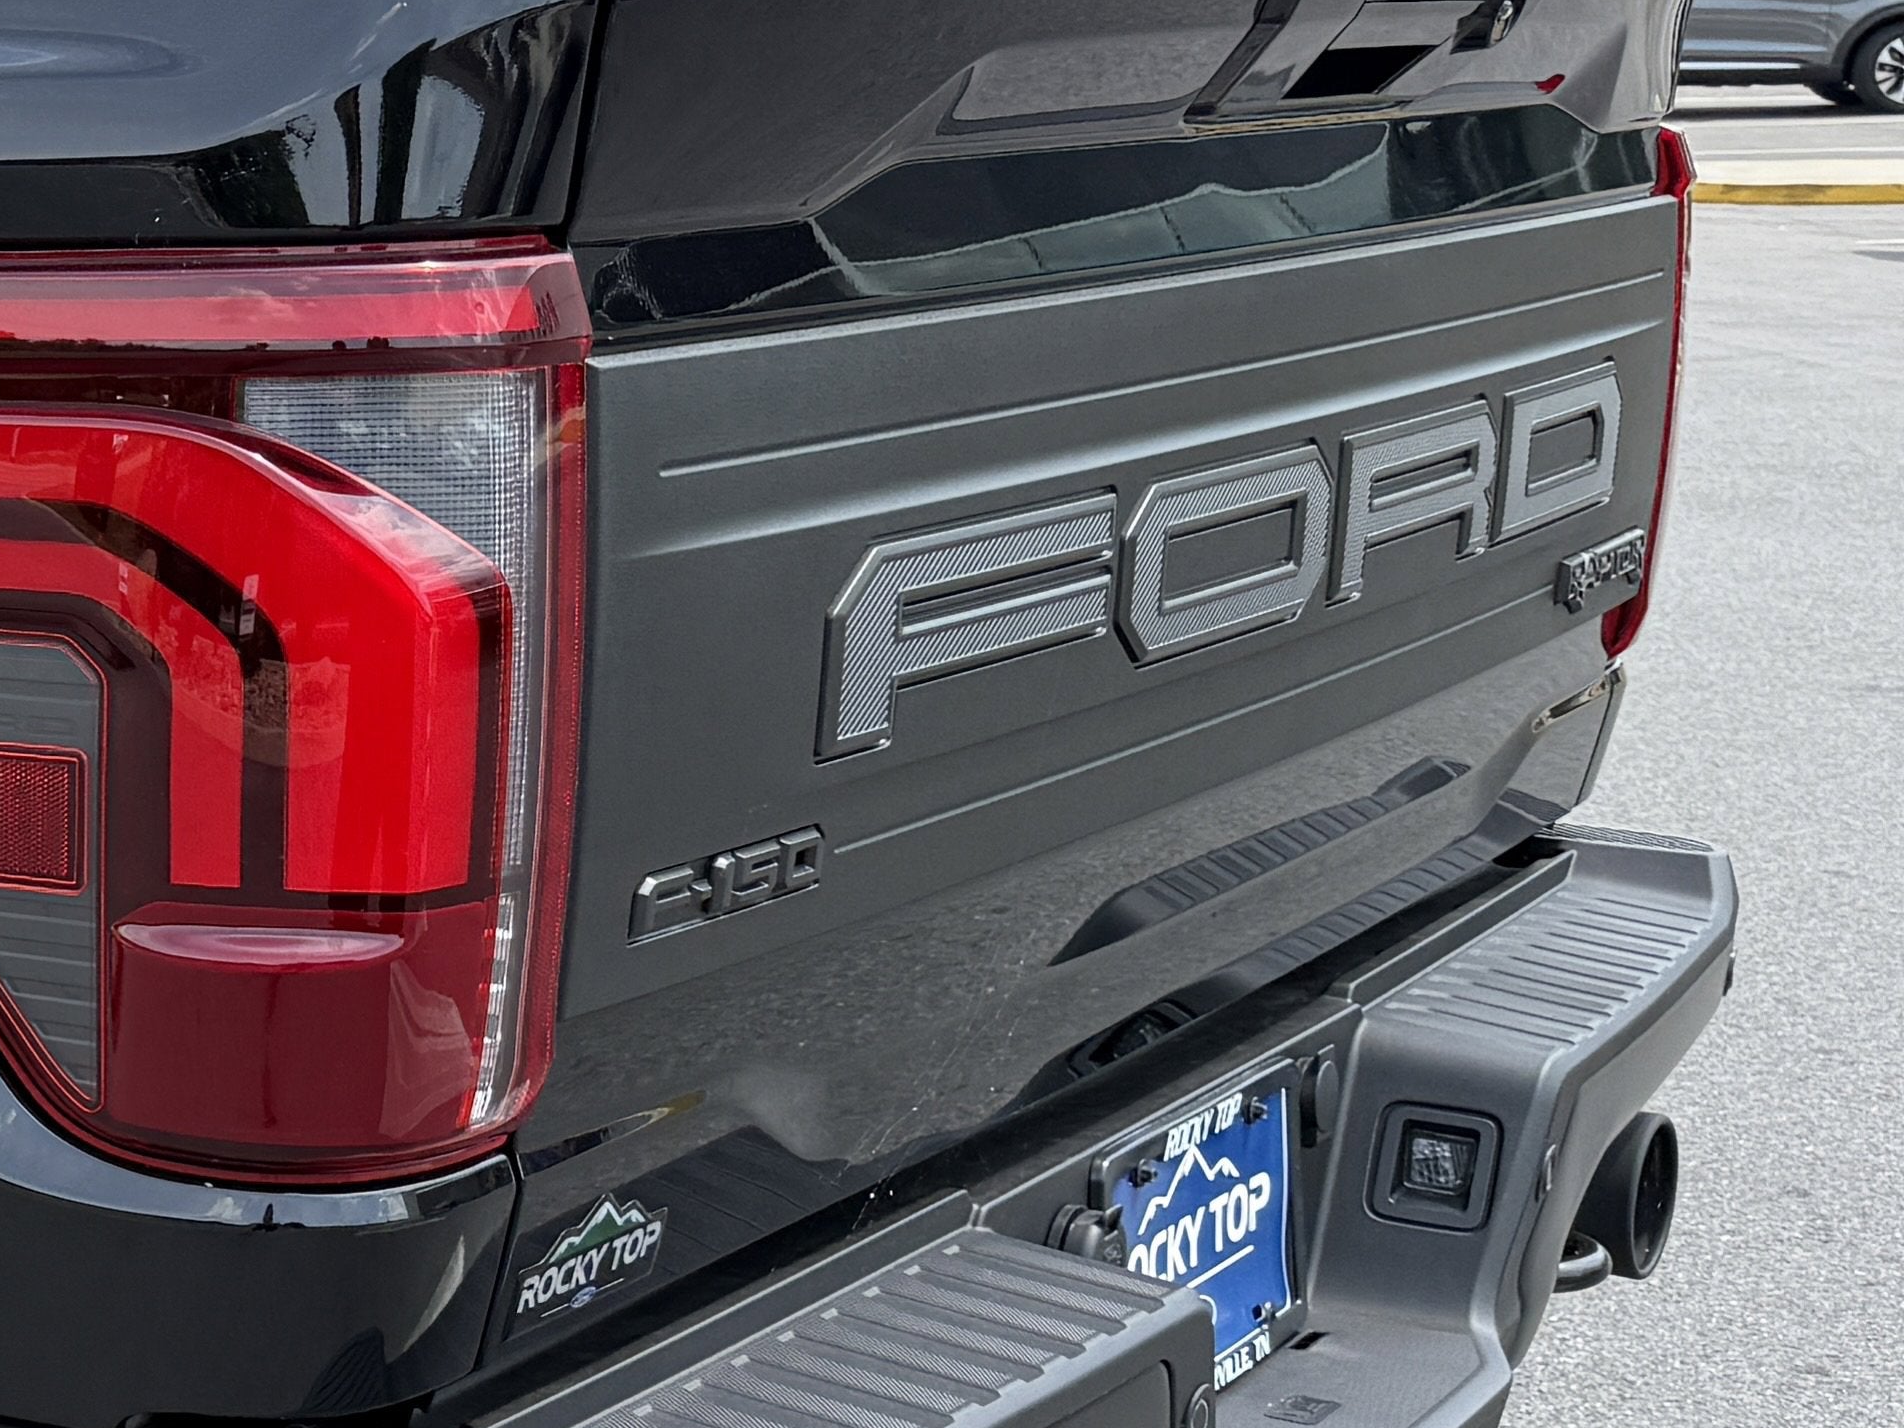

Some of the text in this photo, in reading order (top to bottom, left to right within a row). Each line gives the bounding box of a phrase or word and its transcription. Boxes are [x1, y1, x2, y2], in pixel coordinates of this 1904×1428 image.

[813, 358, 1624, 764] FORD
[626, 823, 825, 948] F-150
[1163, 1093, 1243, 1162] ROCKY TOP
[517, 1221, 662, 1314] ROCKY TOP
[1128, 1172, 1271, 1283] OCKY TOP
